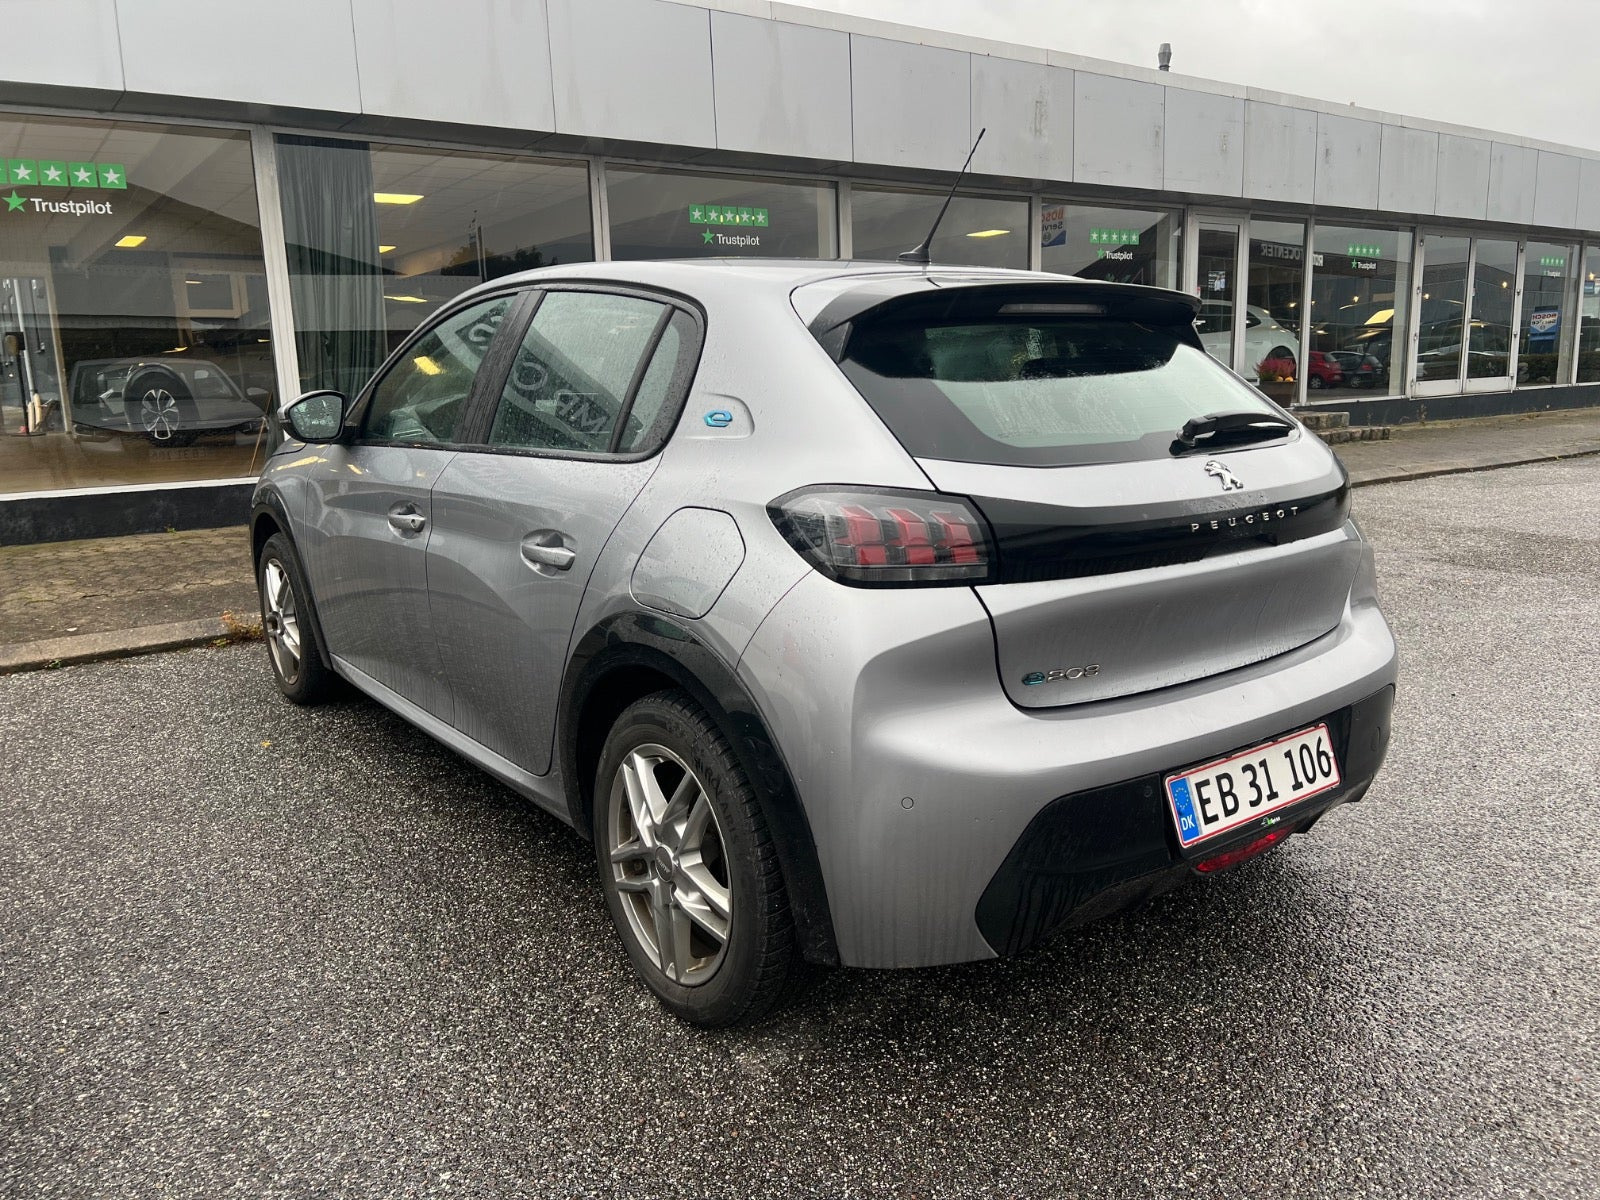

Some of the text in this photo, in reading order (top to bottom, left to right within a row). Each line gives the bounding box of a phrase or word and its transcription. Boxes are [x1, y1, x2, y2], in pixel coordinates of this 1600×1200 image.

[30, 198, 113, 217] Trustpilot
[716, 233, 760, 247] Trustpilot
[1105, 250, 1133, 261] Trustpilot
[1191, 506, 1299, 533] PEUGEOT
[1195, 736, 1332, 826] EB 31 106
[1181, 815, 1195, 831] DK
